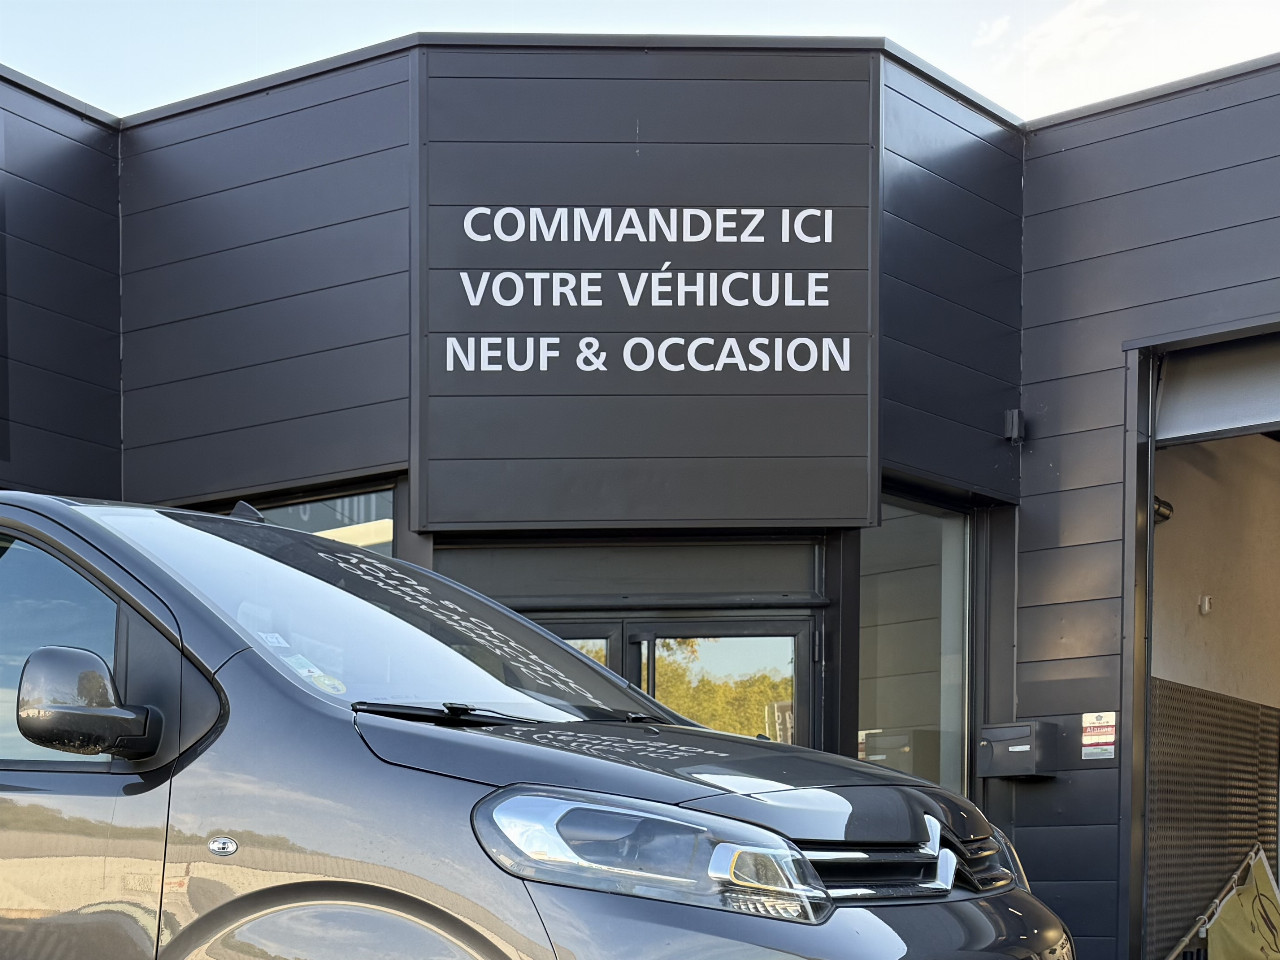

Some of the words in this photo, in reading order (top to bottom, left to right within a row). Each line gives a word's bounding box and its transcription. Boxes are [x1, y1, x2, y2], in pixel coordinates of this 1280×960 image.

[463, 207, 765, 243] COMMANDEZ
[781, 208, 833, 243] ICI
[460, 271, 603, 307] VOTRE
[618, 261, 829, 307] VÉHICULE
[446, 337, 560, 372] NEUF
[576, 336, 607, 372] &
[623, 336, 850, 372] OCCASION
